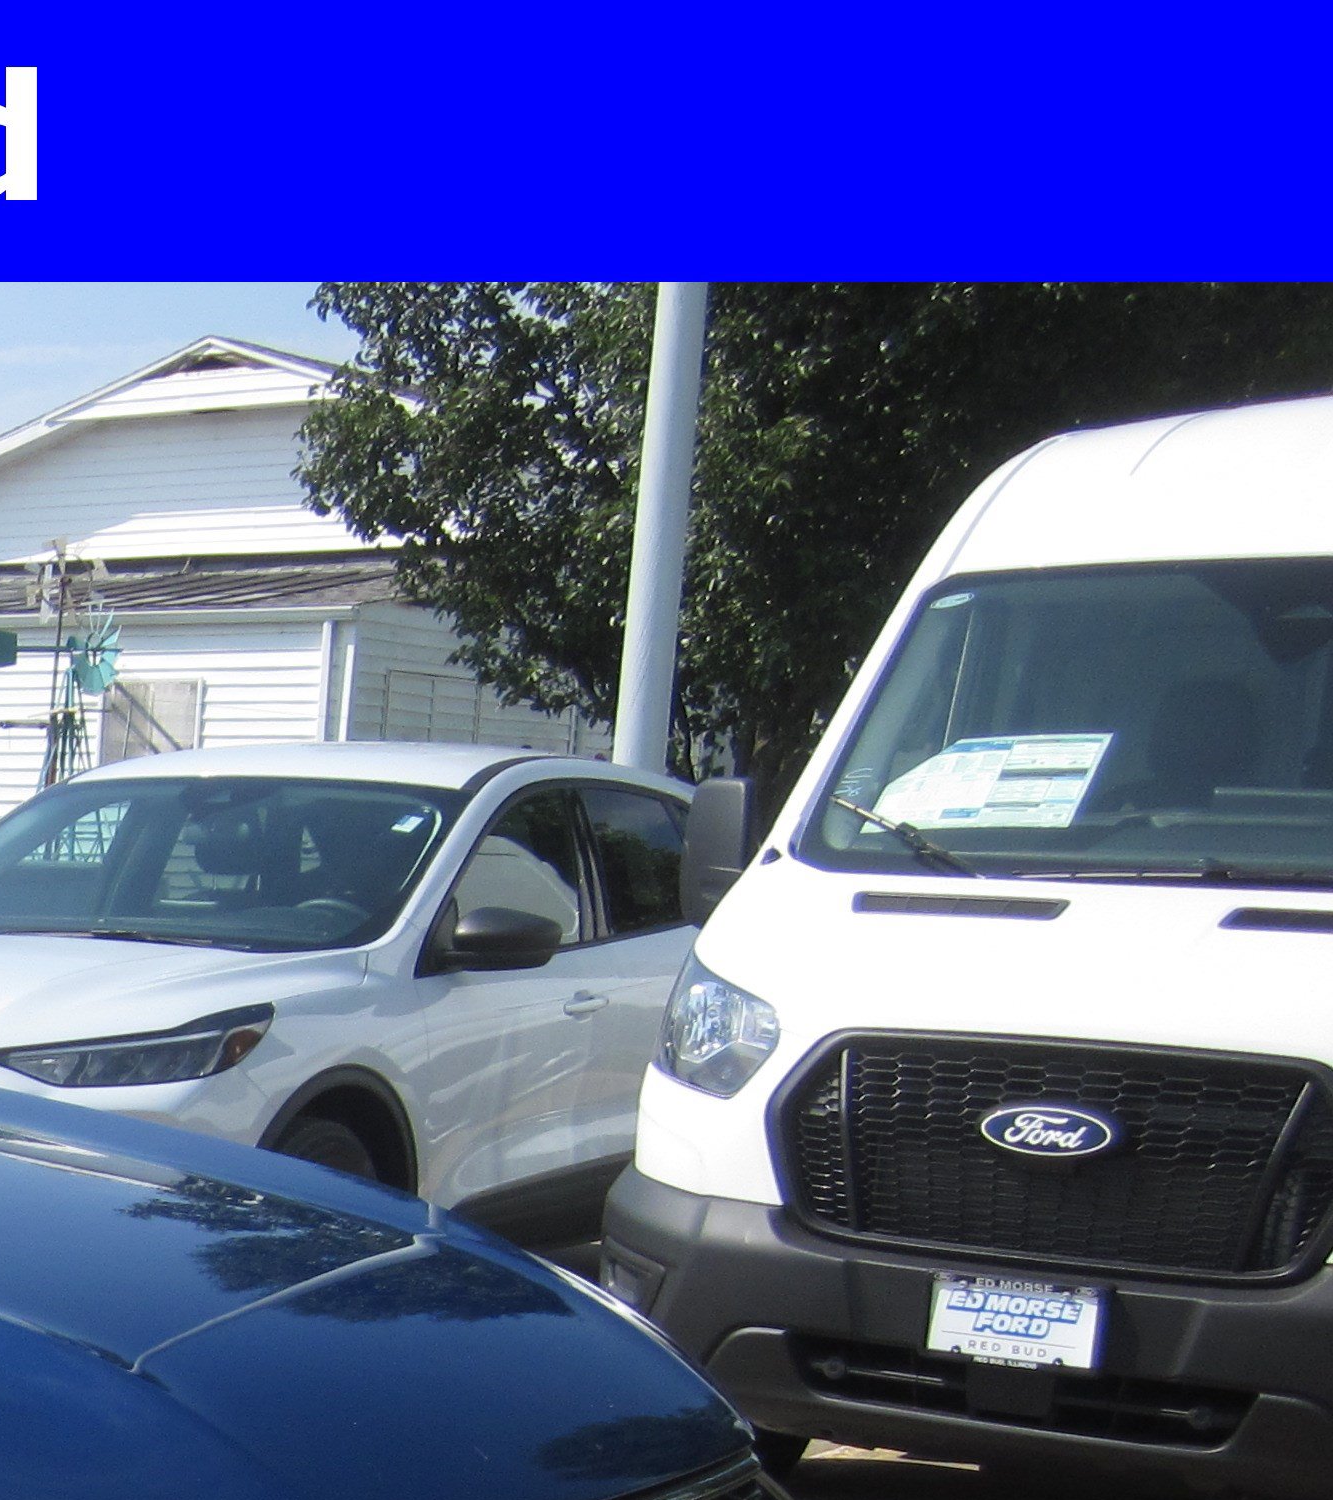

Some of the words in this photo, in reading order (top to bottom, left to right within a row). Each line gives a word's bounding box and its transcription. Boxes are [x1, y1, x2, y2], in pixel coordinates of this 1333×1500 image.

[1003, 1112, 1088, 1149] Ford
[948, 1289, 984, 1309] ED
[984, 1293, 1082, 1322] MORSE
[973, 1312, 1050, 1337] FORD
[967, 1339, 1002, 1353] RED
[1011, 1344, 1048, 1358] BUD
